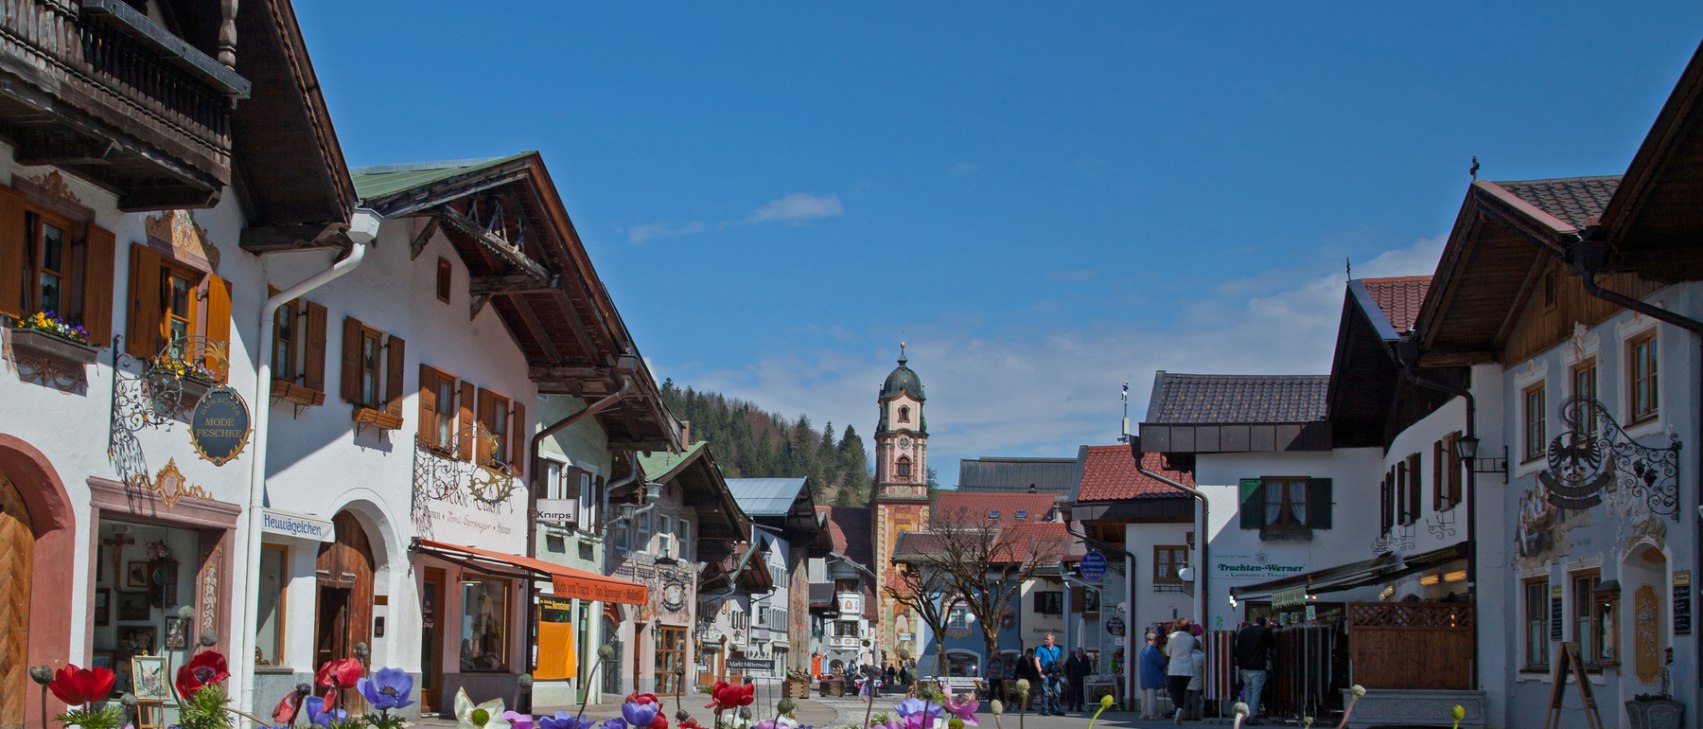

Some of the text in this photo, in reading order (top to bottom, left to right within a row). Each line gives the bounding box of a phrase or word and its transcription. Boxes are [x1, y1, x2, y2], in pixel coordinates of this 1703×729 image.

[205, 417, 235, 427] MODE
[196, 428, 242, 438] PESCHKE
[537, 510, 572, 523] Knirps
[263, 513, 322, 536] Heuwägelchen
[1217, 563, 1304, 573] Trachten-Werner
